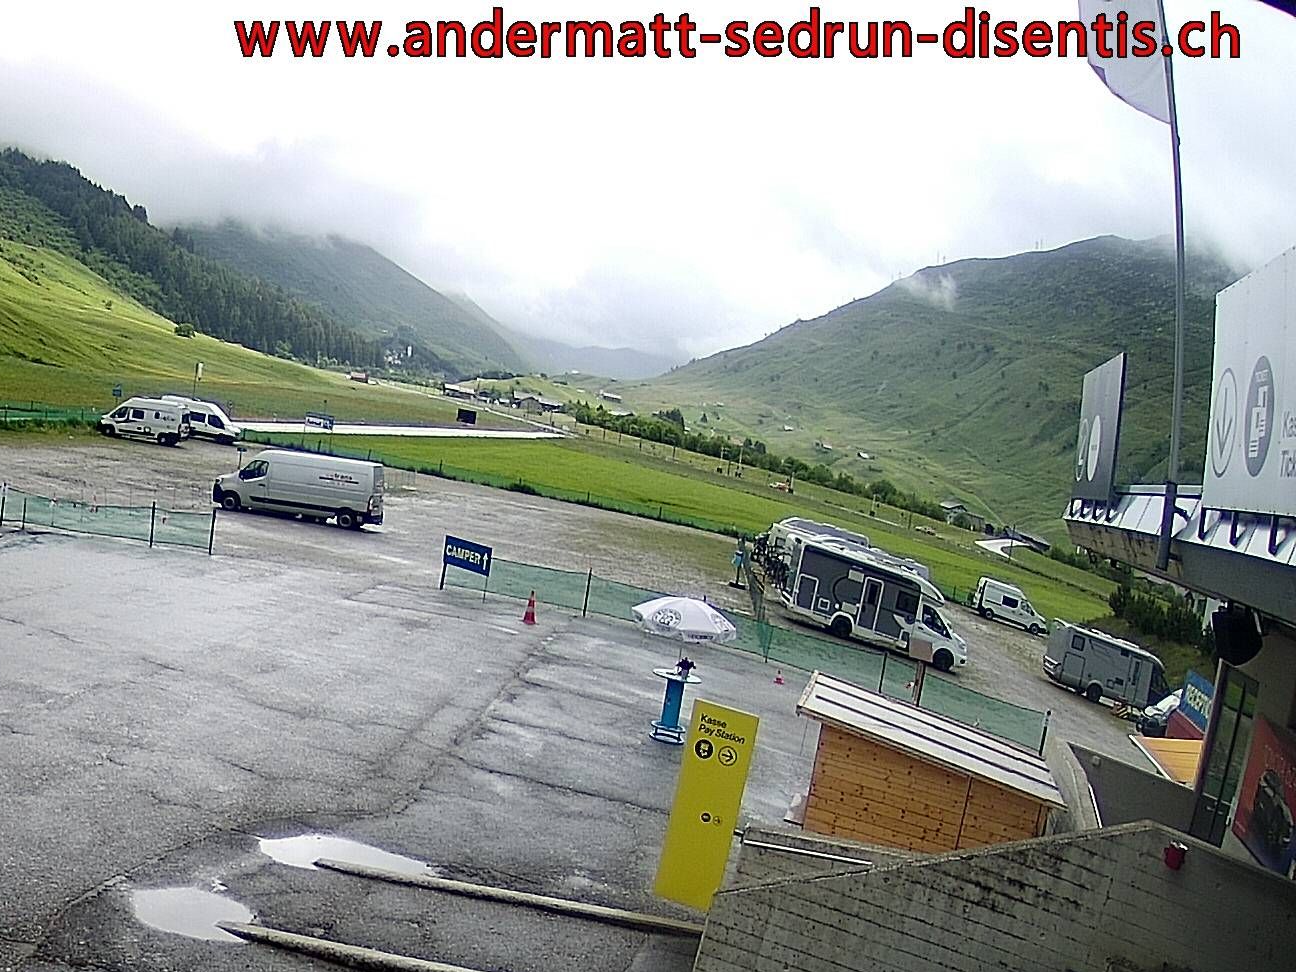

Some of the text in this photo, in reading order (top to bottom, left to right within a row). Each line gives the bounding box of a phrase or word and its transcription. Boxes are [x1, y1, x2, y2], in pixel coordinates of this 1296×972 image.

[445, 544, 482, 565] CAMPER
[700, 713, 727, 729] Kasse
[698, 723, 746, 745] Pay Station
